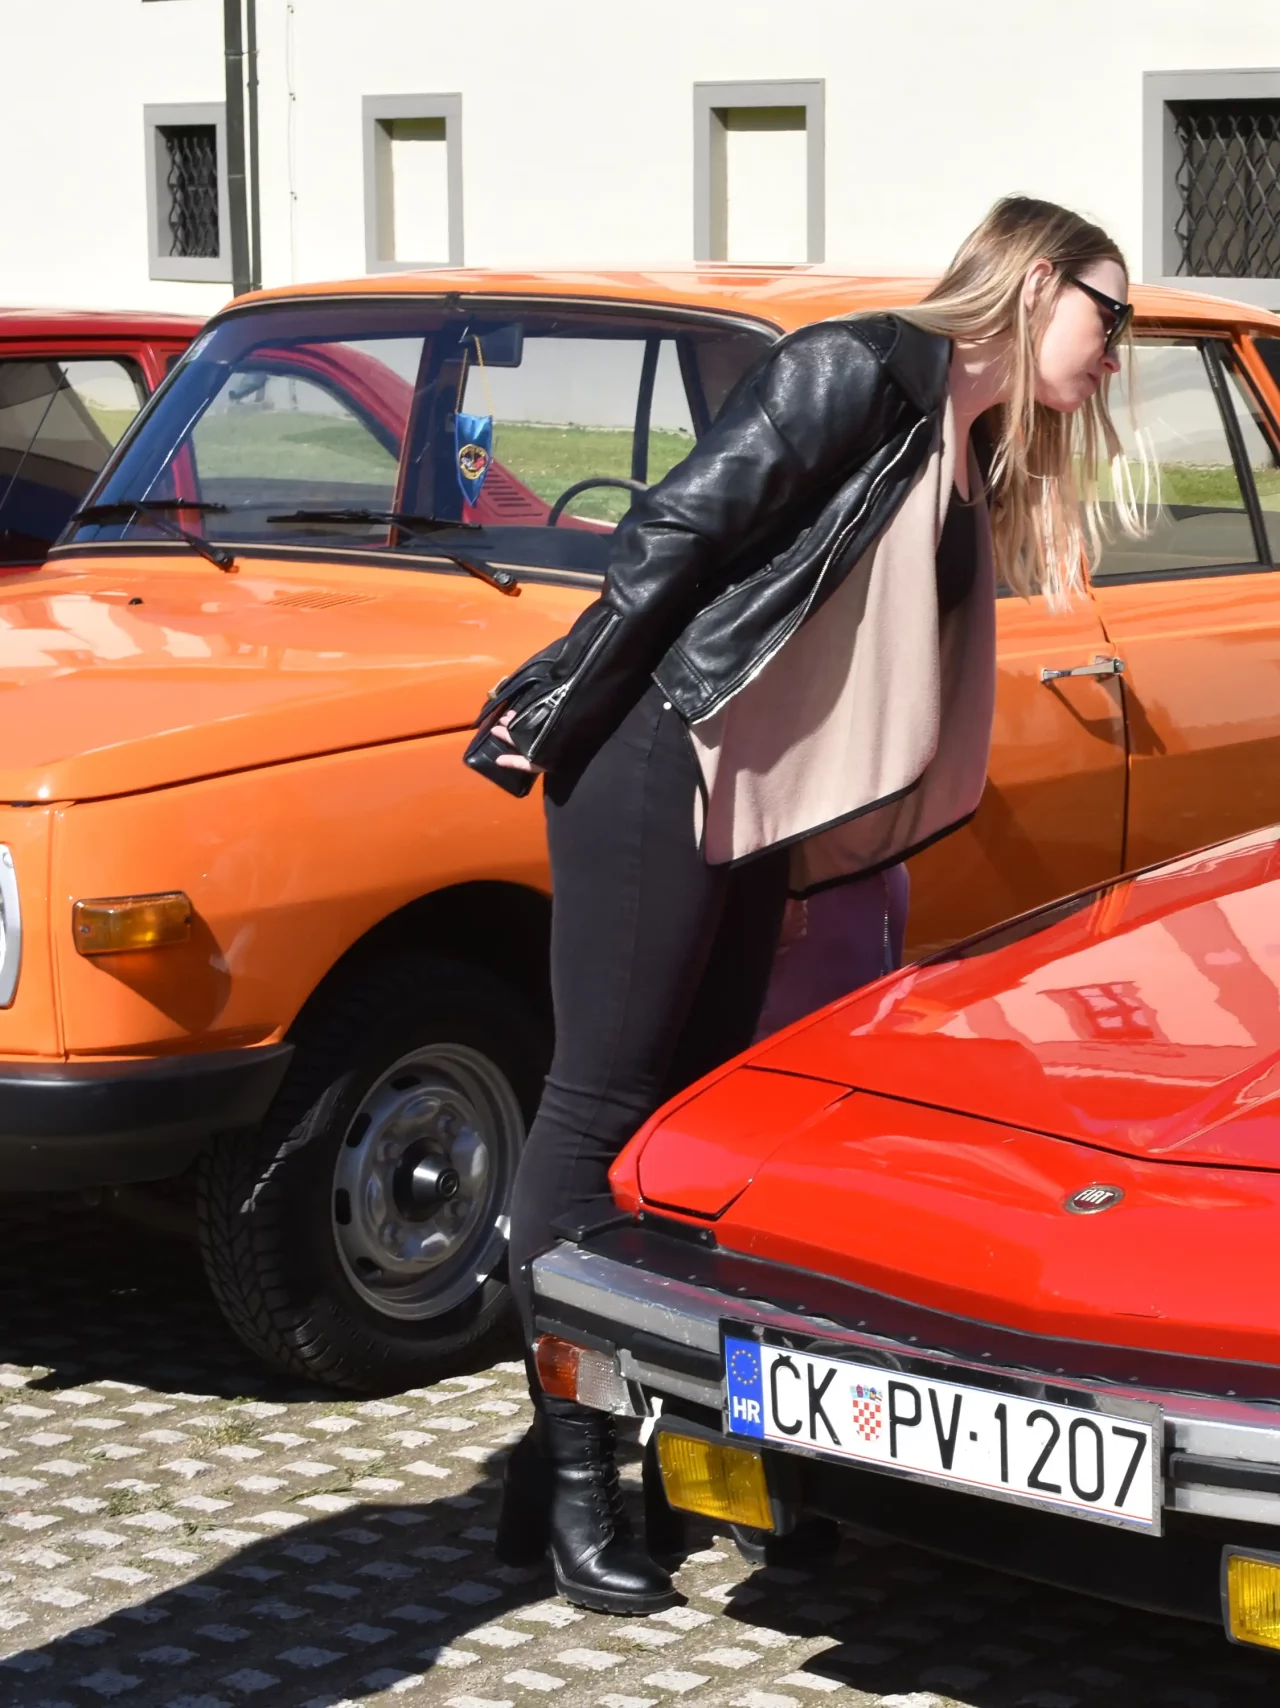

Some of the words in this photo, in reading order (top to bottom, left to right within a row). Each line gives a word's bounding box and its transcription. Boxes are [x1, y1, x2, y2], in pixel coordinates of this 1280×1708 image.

[1074, 1187, 1114, 1205] FIAT
[732, 1396, 761, 1424] HR
[769, 1352, 841, 1446] ČK
